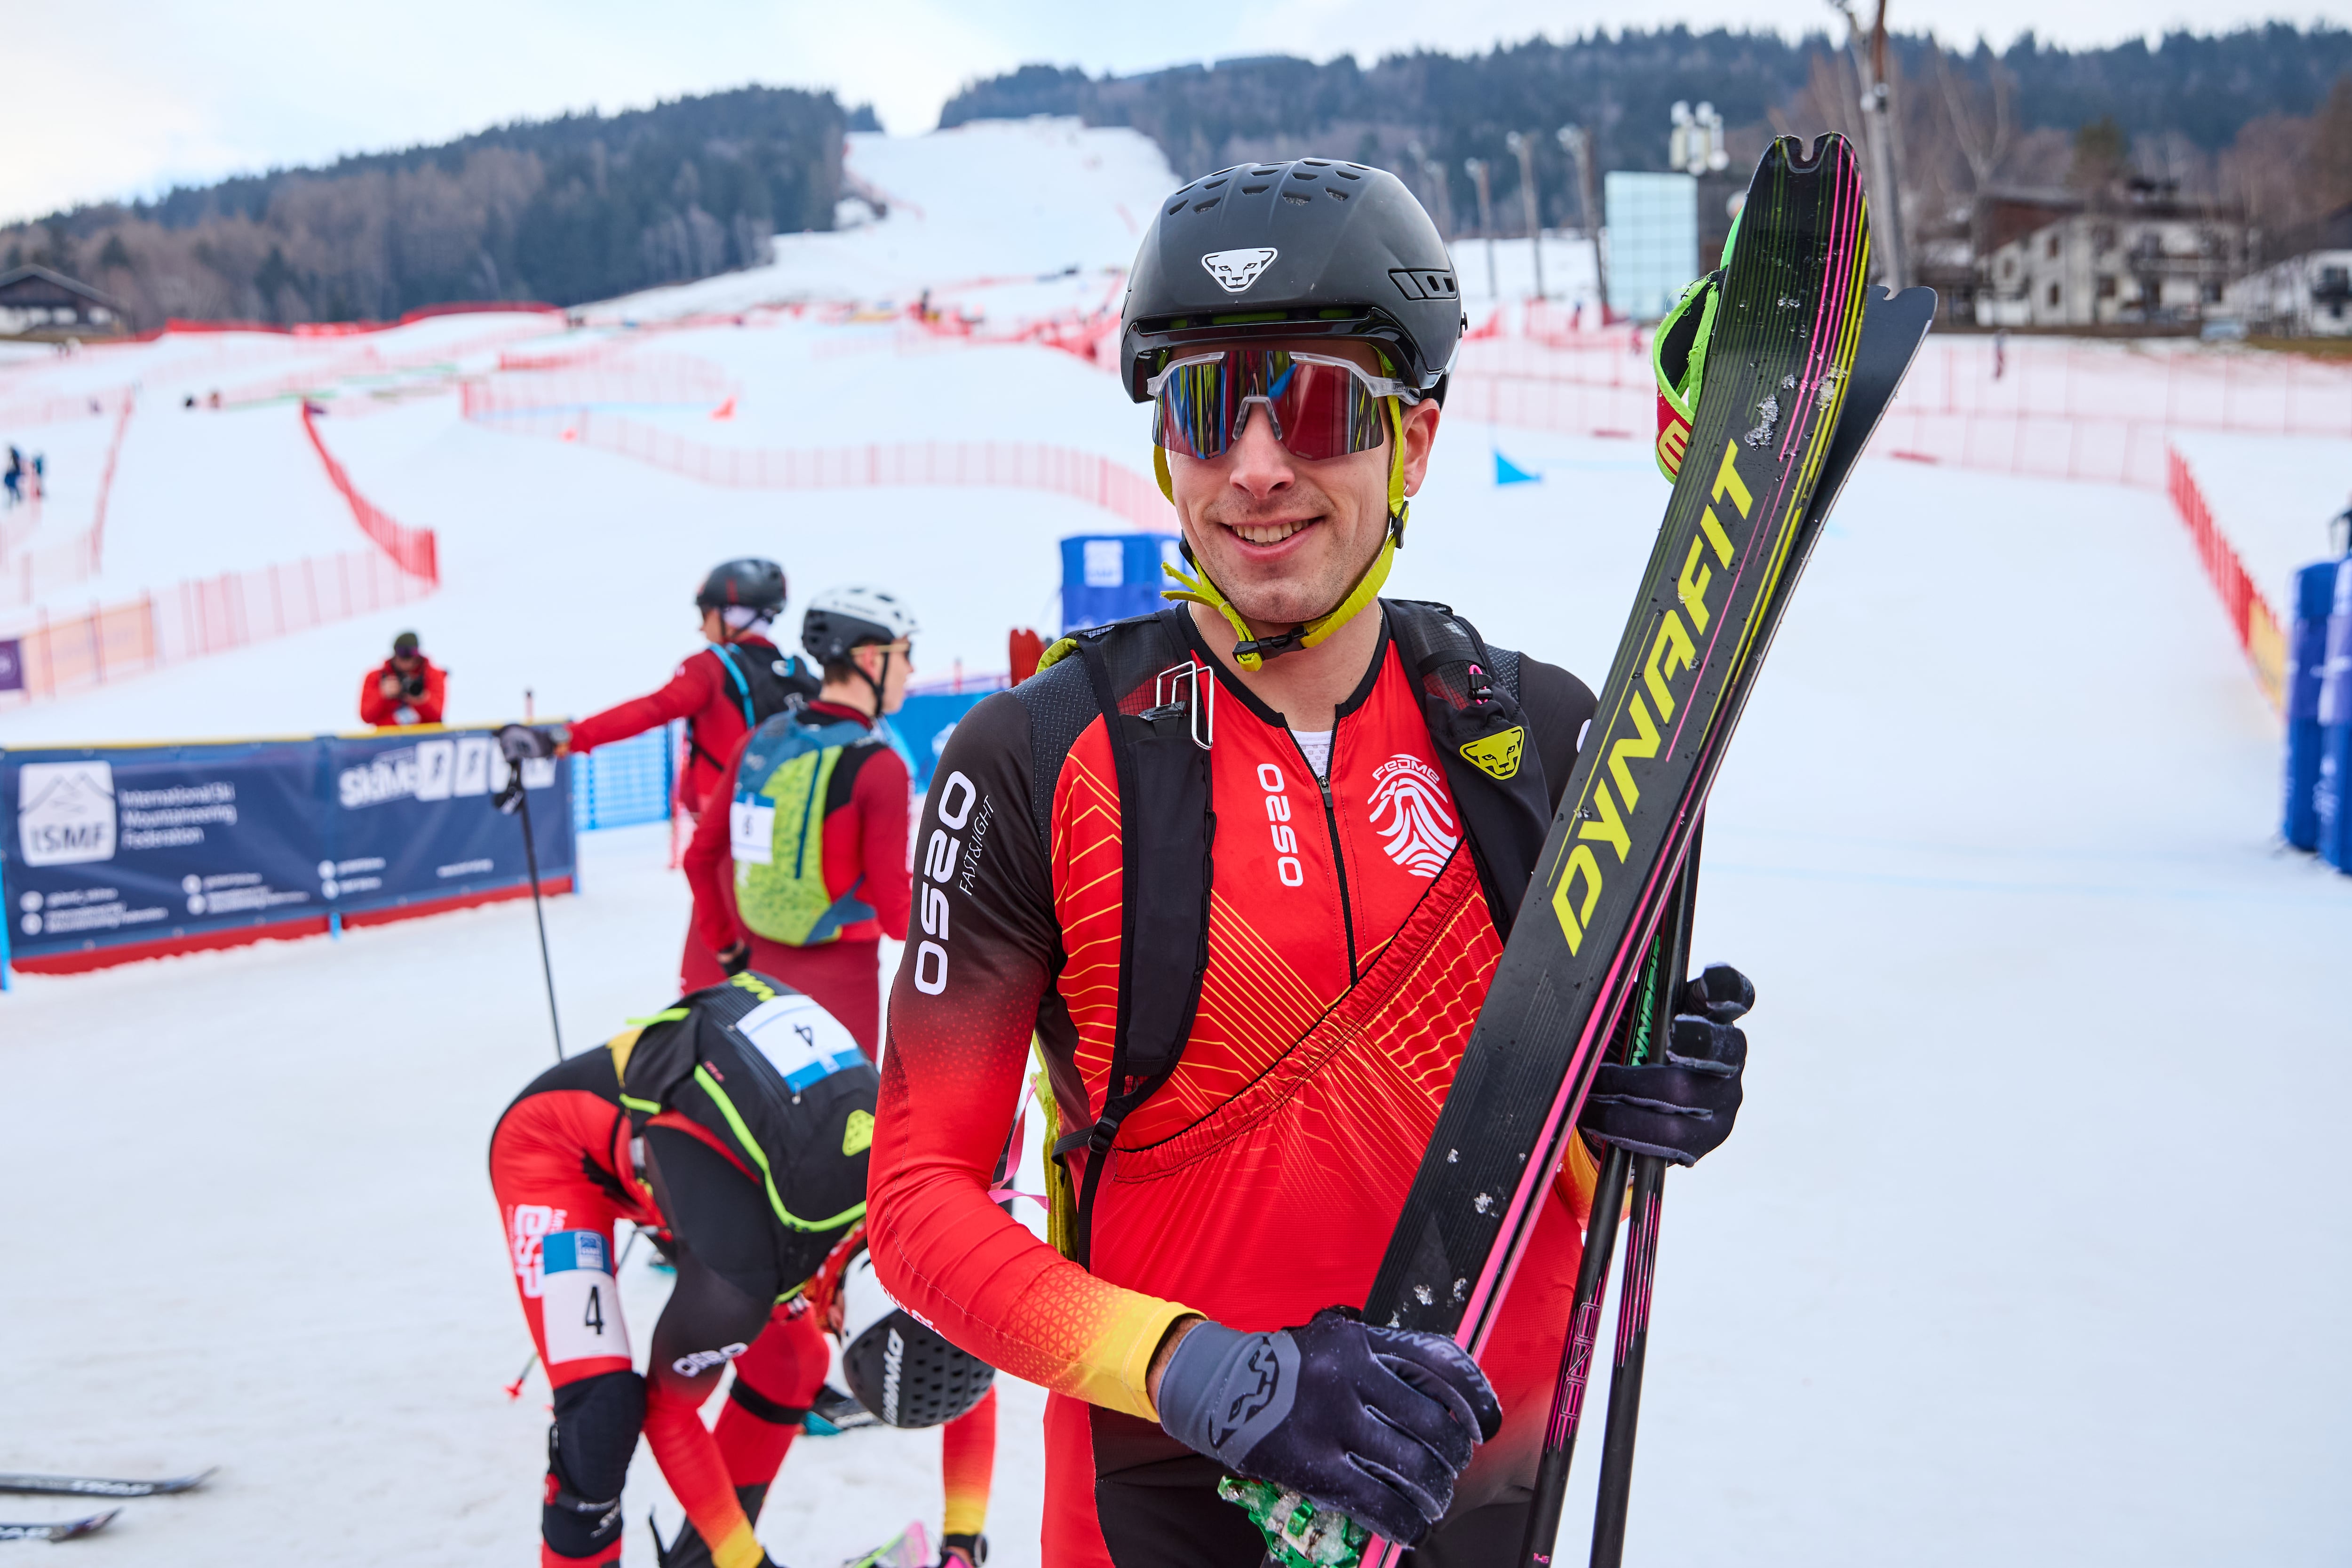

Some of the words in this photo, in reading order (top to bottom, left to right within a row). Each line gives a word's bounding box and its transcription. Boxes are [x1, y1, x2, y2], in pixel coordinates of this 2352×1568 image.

[1552, 438, 1753, 957] DYNAFIT
[31, 822, 107, 851] ISMF
[794, 1024, 813, 1047] 4
[585, 1285, 604, 1335] 4
[1367, 1327, 1492, 1393] DYNAFIT
